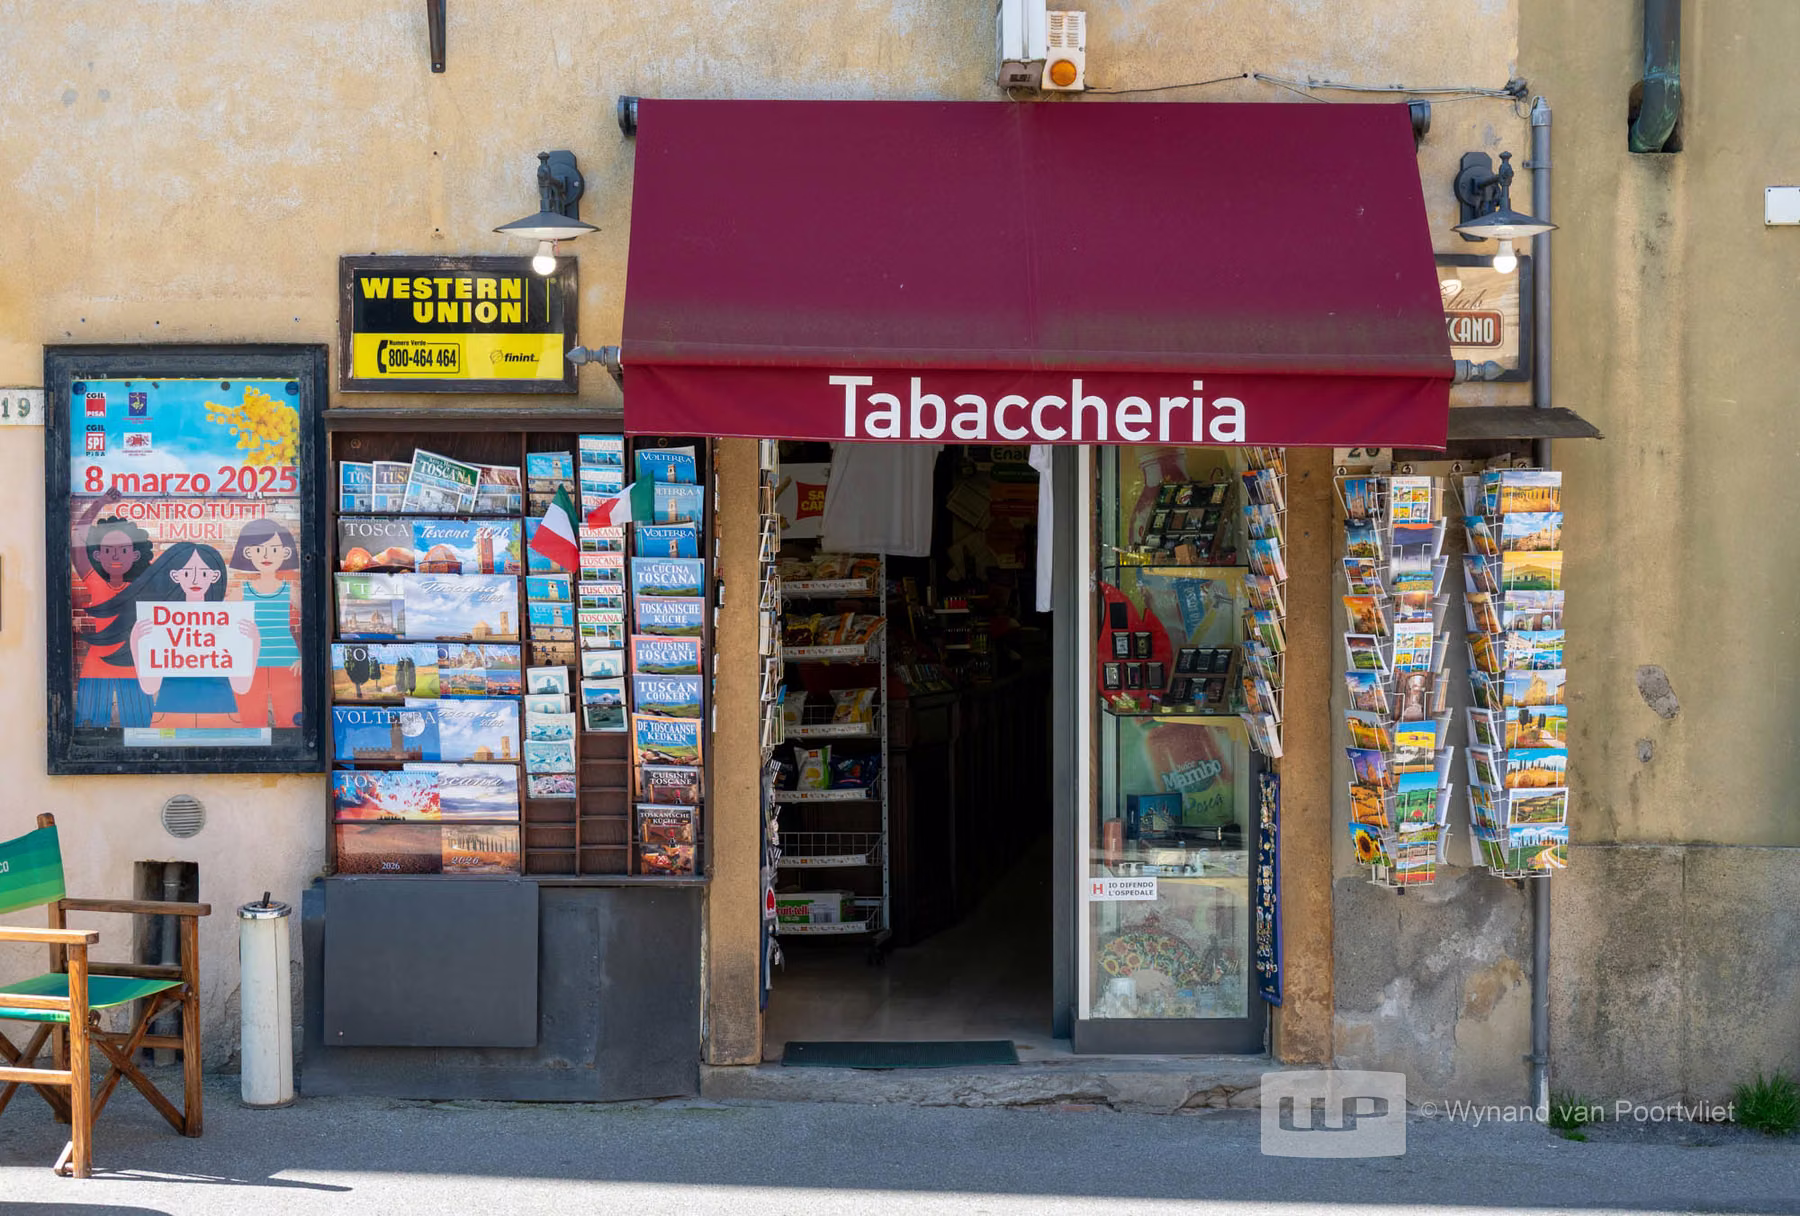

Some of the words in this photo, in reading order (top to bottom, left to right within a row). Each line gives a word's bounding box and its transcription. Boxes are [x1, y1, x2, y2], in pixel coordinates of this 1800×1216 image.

[360, 277, 522, 299] WESTERN
[413, 301, 522, 323] UNION
[388, 349, 433, 367] 800-464
[436, 349, 456, 367] 464
[828, 374, 1246, 442] Tabaccheria
[86, 424, 105, 432] CGIL
[87, 436, 103, 450] SPI
[641, 451, 692, 464] VOLTERRA
[85, 466, 104, 493] 8
[111, 471, 211, 493] marzo
[217, 466, 298, 493] 2025
[420, 460, 472, 485] TOSCANA
[115, 503, 201, 520] CONTRO
[202, 503, 265, 520] TUTTI
[159, 523, 164, 539] I
[169, 523, 223, 539] MURI
[345, 523, 410, 537] TOSCA
[421, 525, 471, 539] Toscana
[642, 527, 695, 537] VOLTERRA
[651, 564, 690, 574] CUCINA
[636, 571, 697, 585] TOSCANA
[581, 586, 620, 594] TUSCANY
[640, 602, 701, 614] TOSKANISCHE
[153, 606, 230, 626] Donna
[581, 614, 620, 622] TOSCANA
[166, 627, 216, 647] Vita
[650, 641, 691, 651] CUISINE
[150, 648, 233, 669] Libertà
[637, 649, 696, 661] TOSCANE
[638, 681, 698, 693] TUSCAN
[646, 691, 692, 701] COOKERY
[335, 711, 437, 724] VOLTERRA
[637, 721, 648, 732] DE
[650, 722, 696, 735] TOSCAANSE
[647, 732, 686, 742] KEUKEN
[651, 771, 689, 779] CUISINE
[1092, 883, 1105, 895] H
